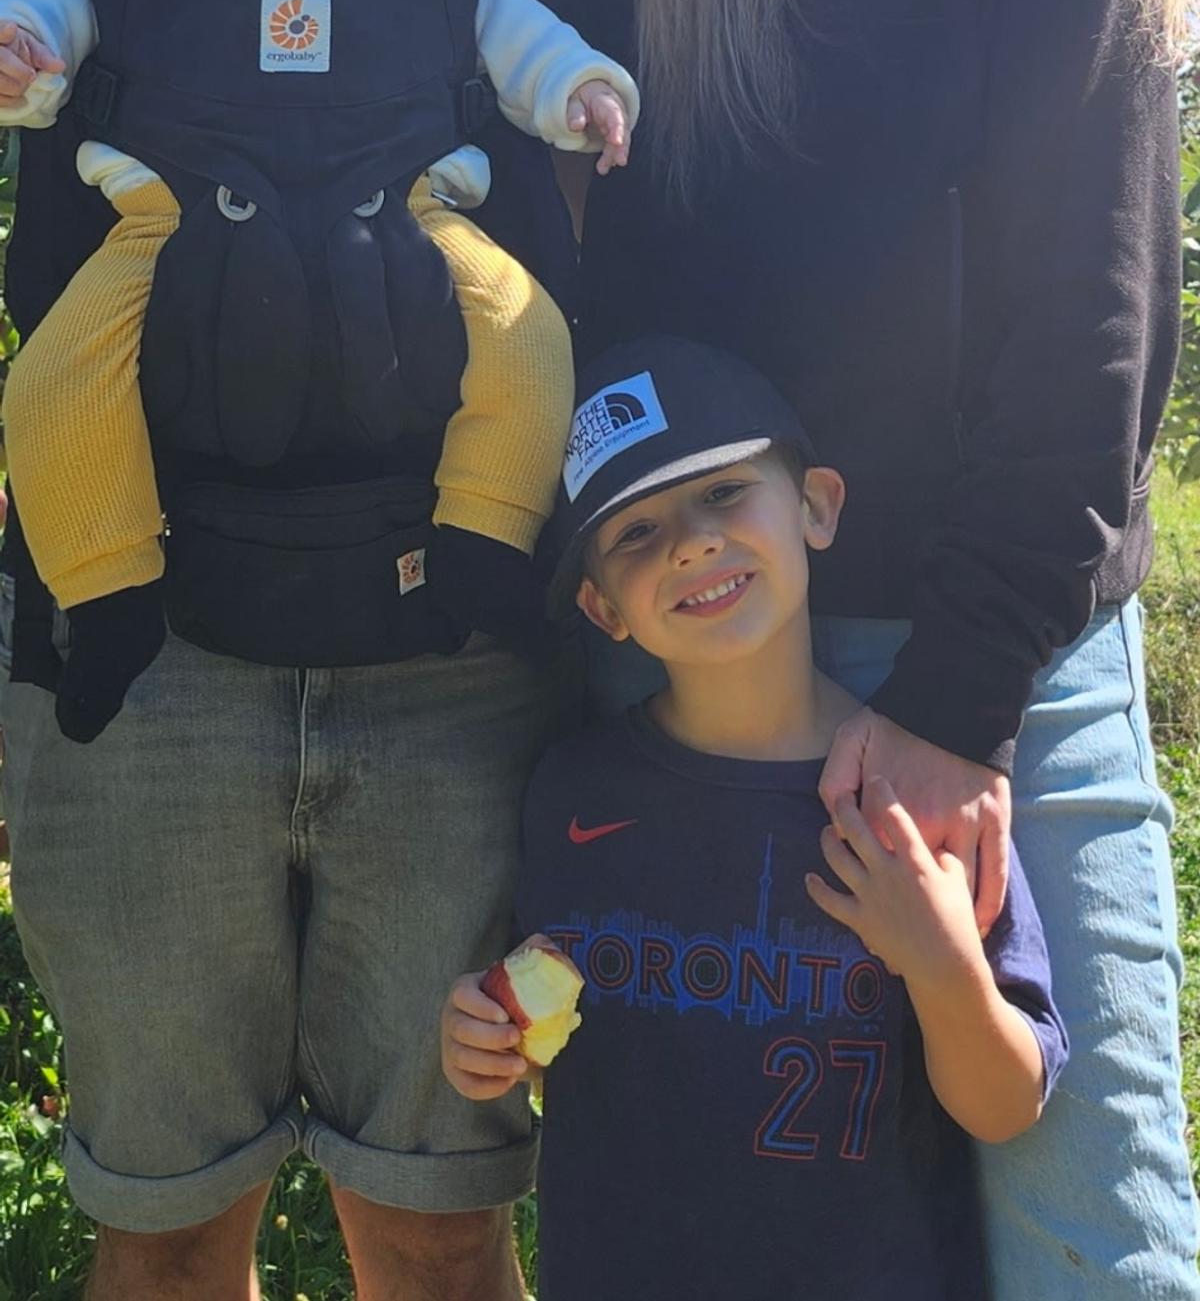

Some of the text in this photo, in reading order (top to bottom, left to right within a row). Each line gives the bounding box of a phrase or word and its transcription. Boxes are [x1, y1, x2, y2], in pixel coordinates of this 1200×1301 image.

[576, 397, 603, 426] THE
[604, 419, 650, 448] Equipment
[566, 410, 610, 462] NORTH
[578, 422, 613, 462] FACE
[546, 927, 885, 1017] TORONTO
[753, 1036, 887, 1160] 27
